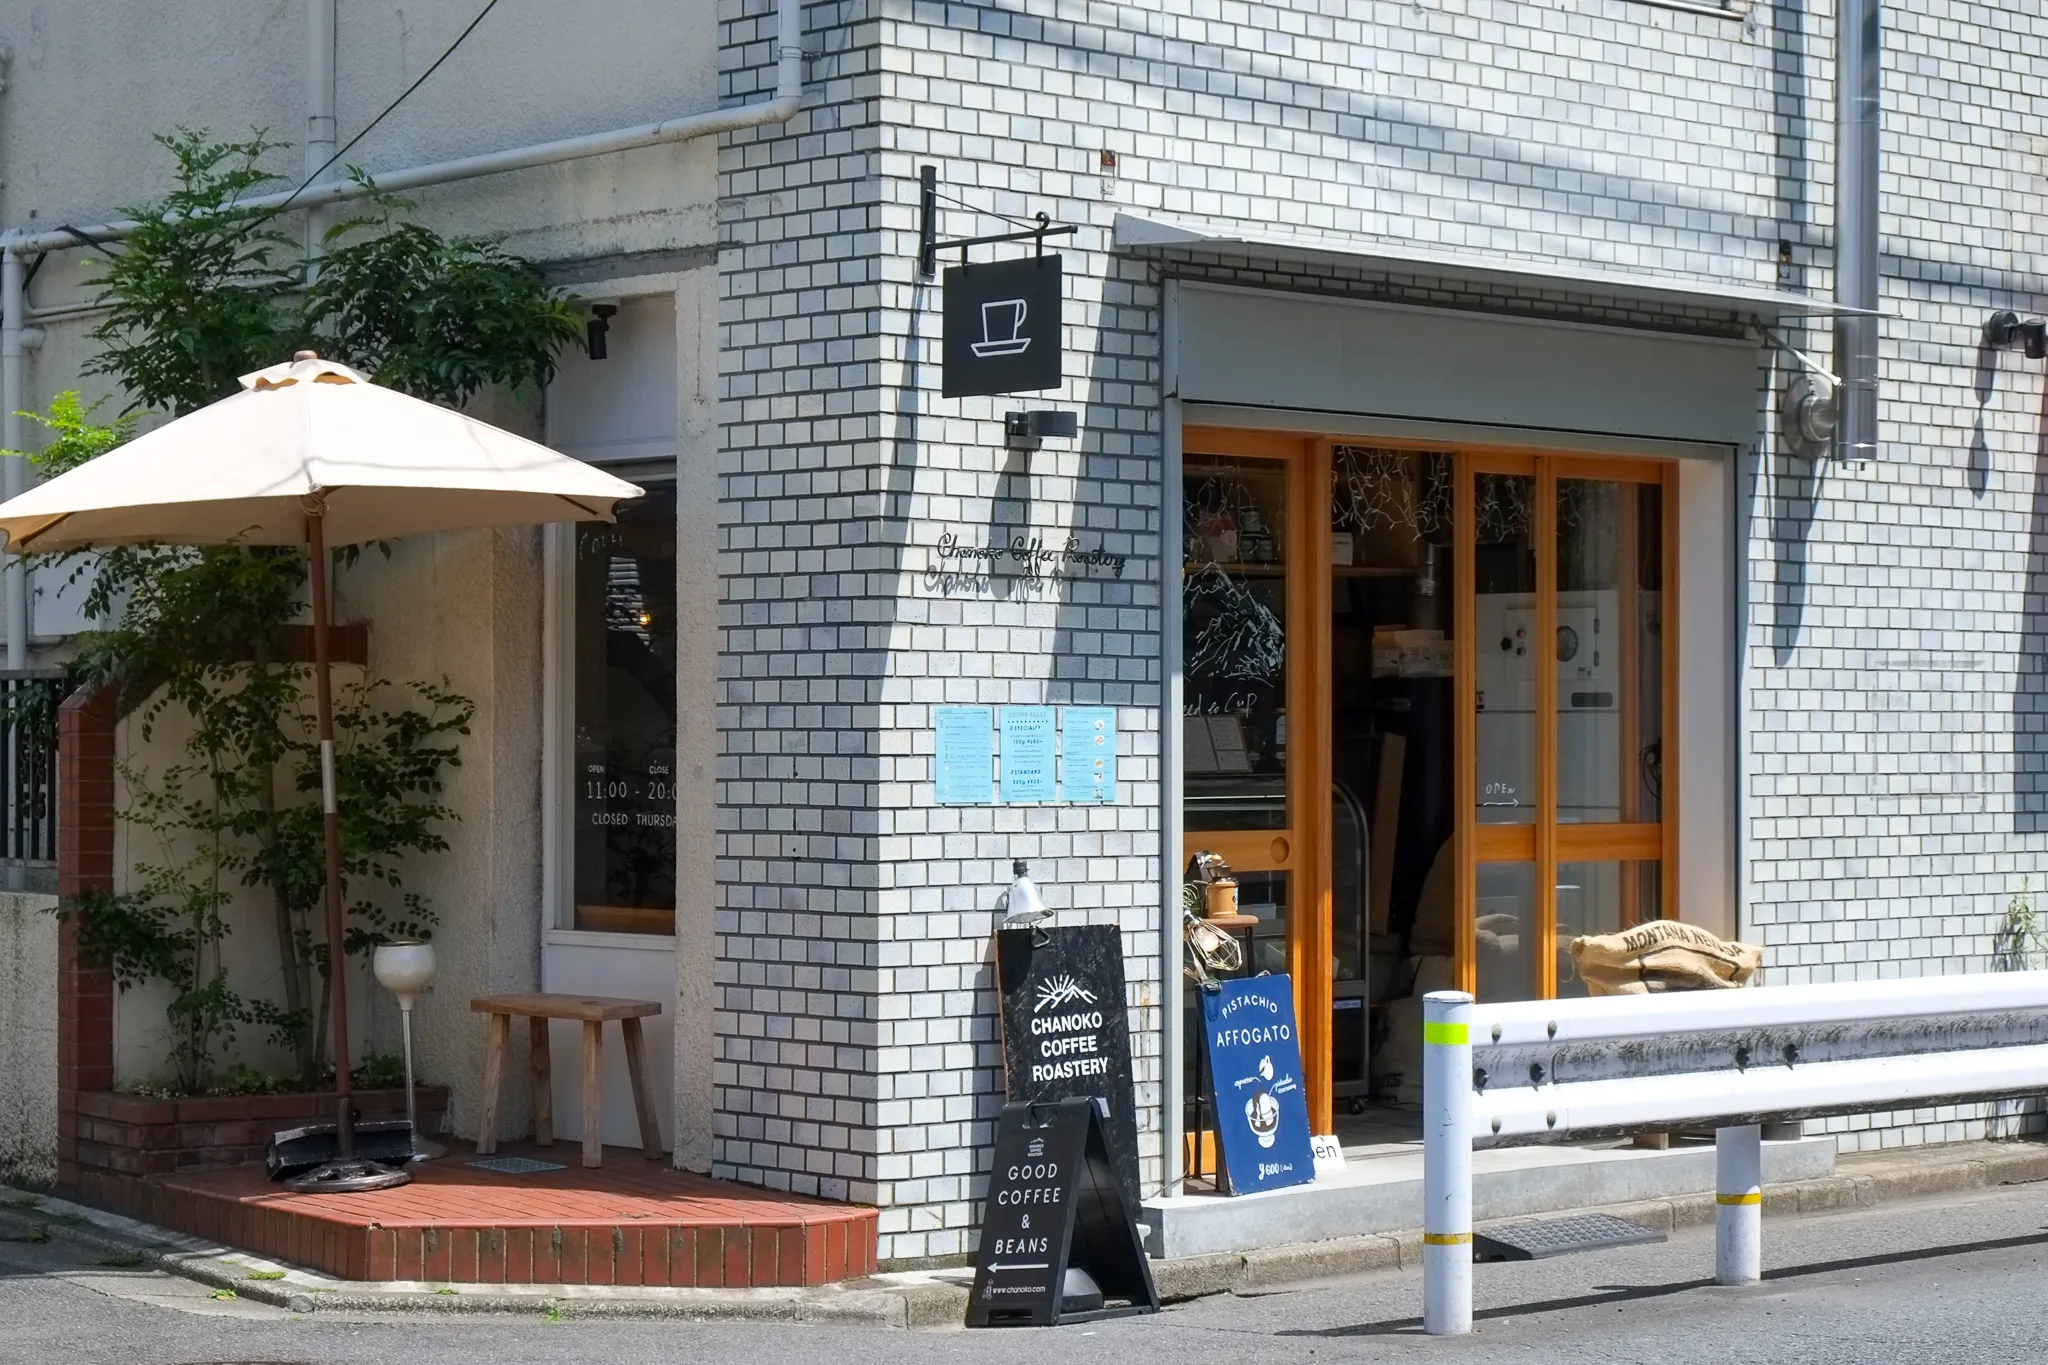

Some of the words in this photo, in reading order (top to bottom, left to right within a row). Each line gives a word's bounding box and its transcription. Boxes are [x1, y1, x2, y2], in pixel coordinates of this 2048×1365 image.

[1011, 536, 1055, 576] Coffee
[587, 764, 605, 773] OPEN
[648, 765, 669, 774] CLOSE
[587, 781, 627, 799] 11:00
[591, 812, 628, 825] CLOSED
[1622, 923, 1690, 952] MONTANA
[1221, 994, 1278, 1019] PISTACHIO
[1031, 1011, 1103, 1035] CHANOKO
[1216, 1024, 1290, 1048] AFFOGATO
[1040, 1035, 1098, 1058] COFFEE
[1032, 1057, 1109, 1082] ROASTERY
[1311, 1146, 1337, 1159] en
[1007, 1163, 1058, 1181] GOOD
[998, 1187, 1061, 1205] COFFEE
[1021, 1213, 1031, 1229] &
[994, 1237, 1048, 1255] BEANS
